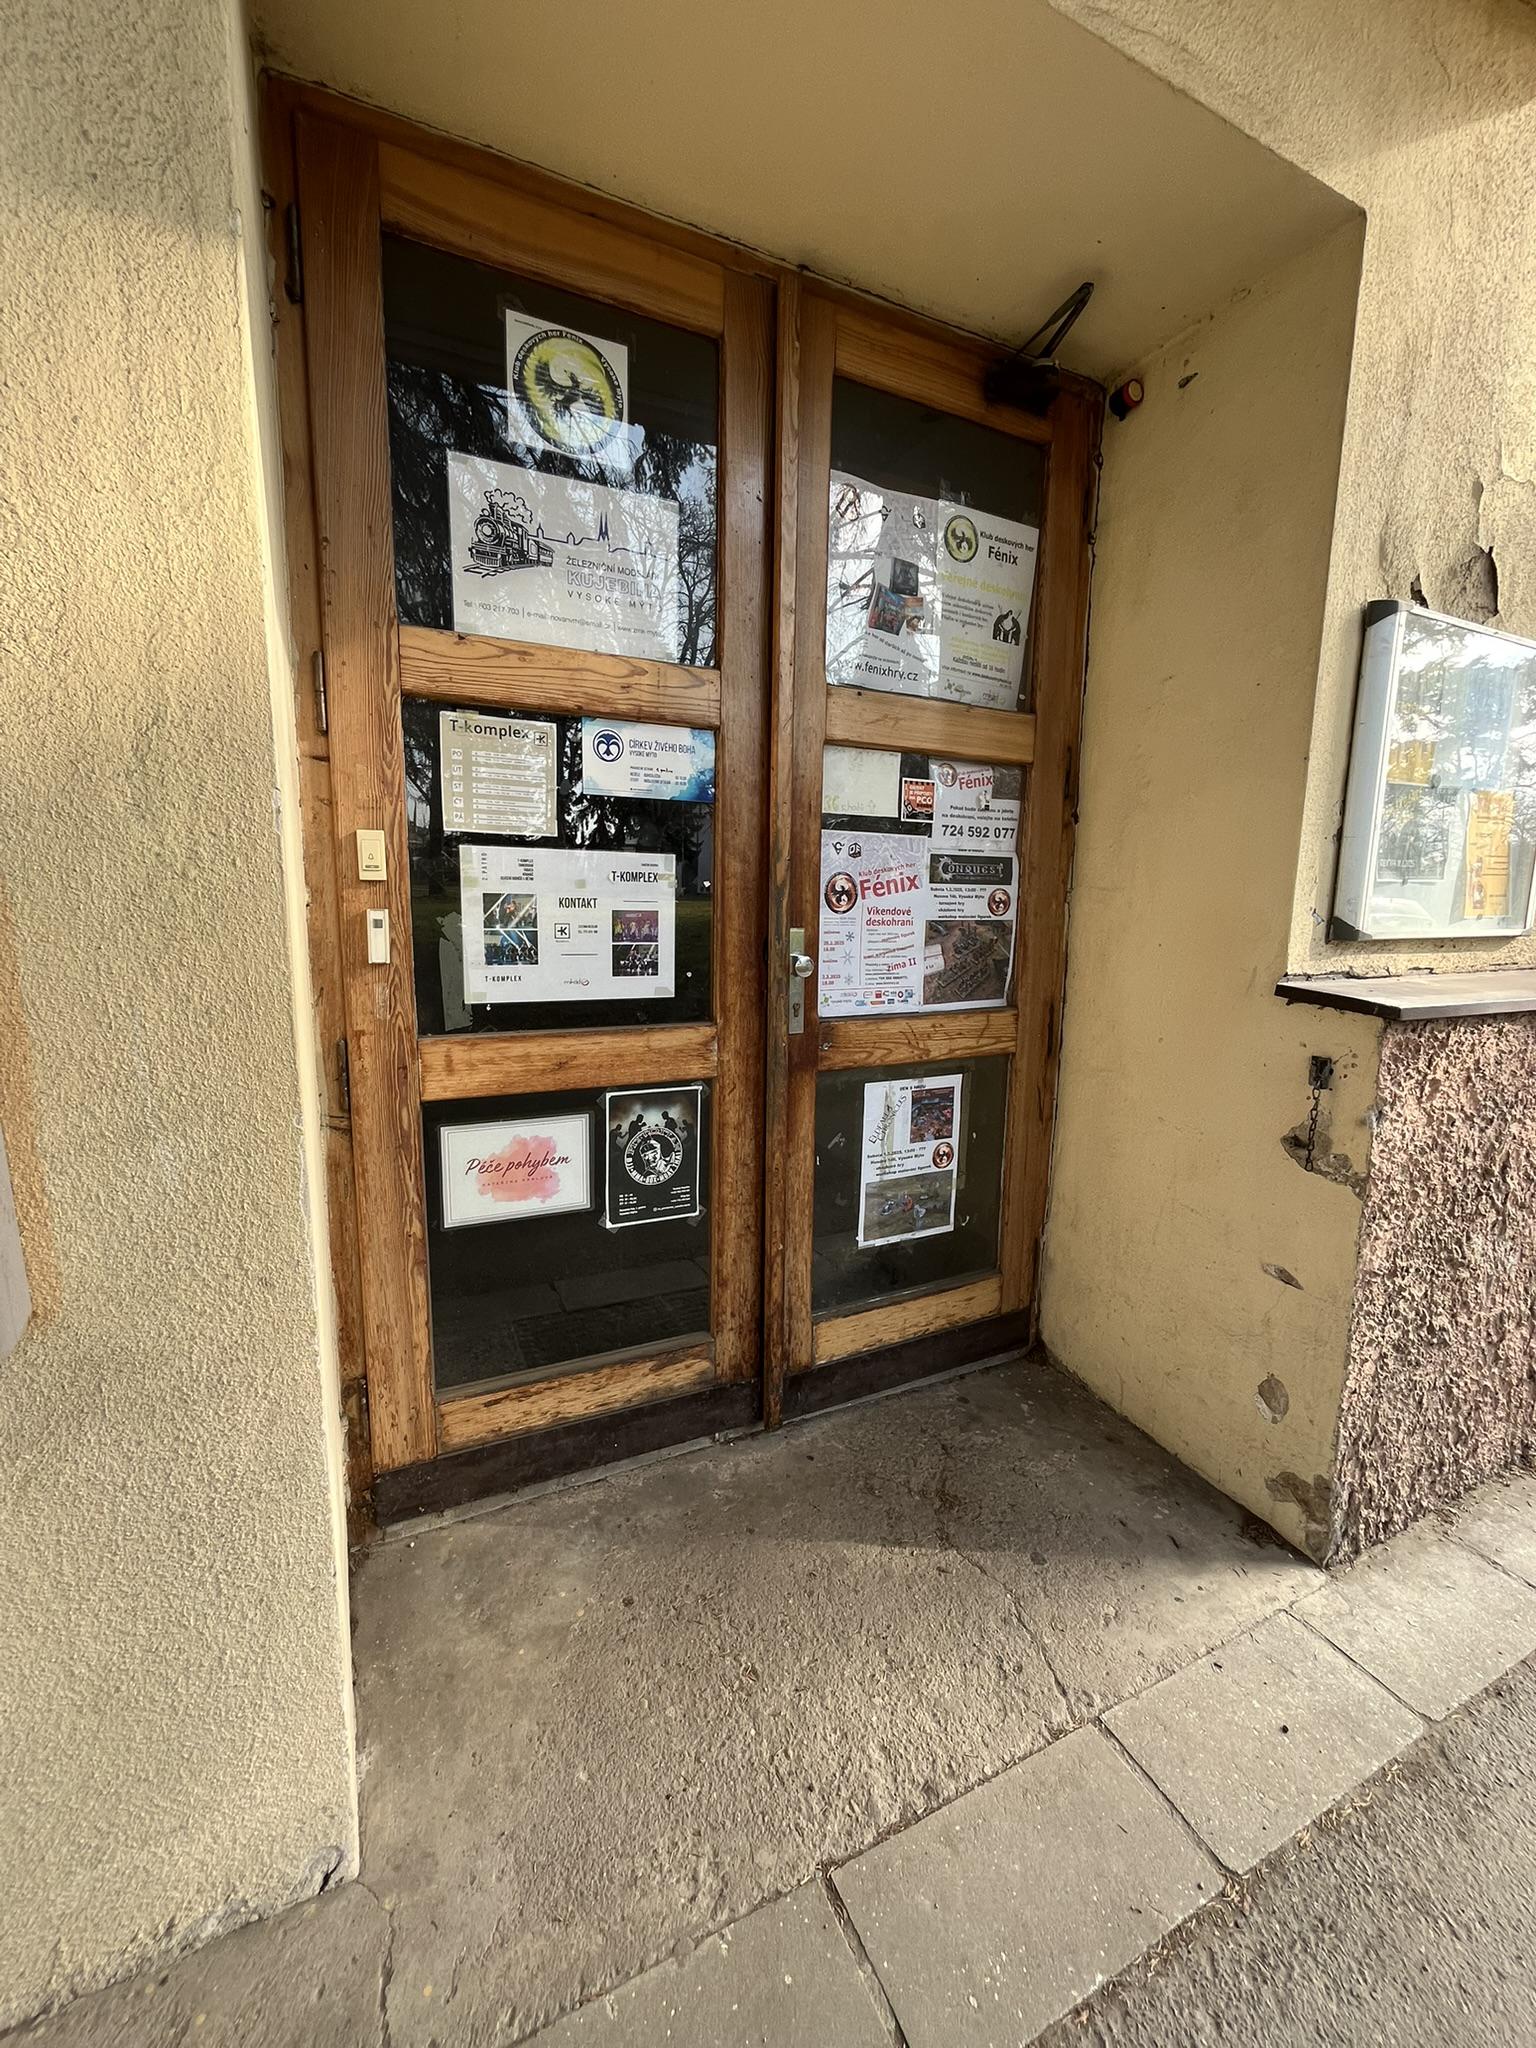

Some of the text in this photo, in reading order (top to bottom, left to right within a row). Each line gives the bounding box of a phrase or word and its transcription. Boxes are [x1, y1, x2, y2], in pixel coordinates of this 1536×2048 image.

[512, 360, 522, 380] Klub
[988, 545, 1018, 566] Fénix
[449, 719, 530, 740] T-komplex
[629, 738, 696, 755] CÍRKEV ŽIVÉHO BOHA
[958, 773, 993, 790] Fénix
[916, 796, 933, 805] PCO
[941, 824, 1016, 839] 724 592 077
[611, 870, 659, 883] T-KOMPLEX
[939, 856, 1004, 881] CONQUEST
[859, 871, 920, 900] Fénix
[559, 897, 598, 909] KONTAKT
[866, 905, 912, 917] Víkendové
[866, 916, 914, 927] deskohraní
[465, 1151, 571, 1178] Péče pohybem
